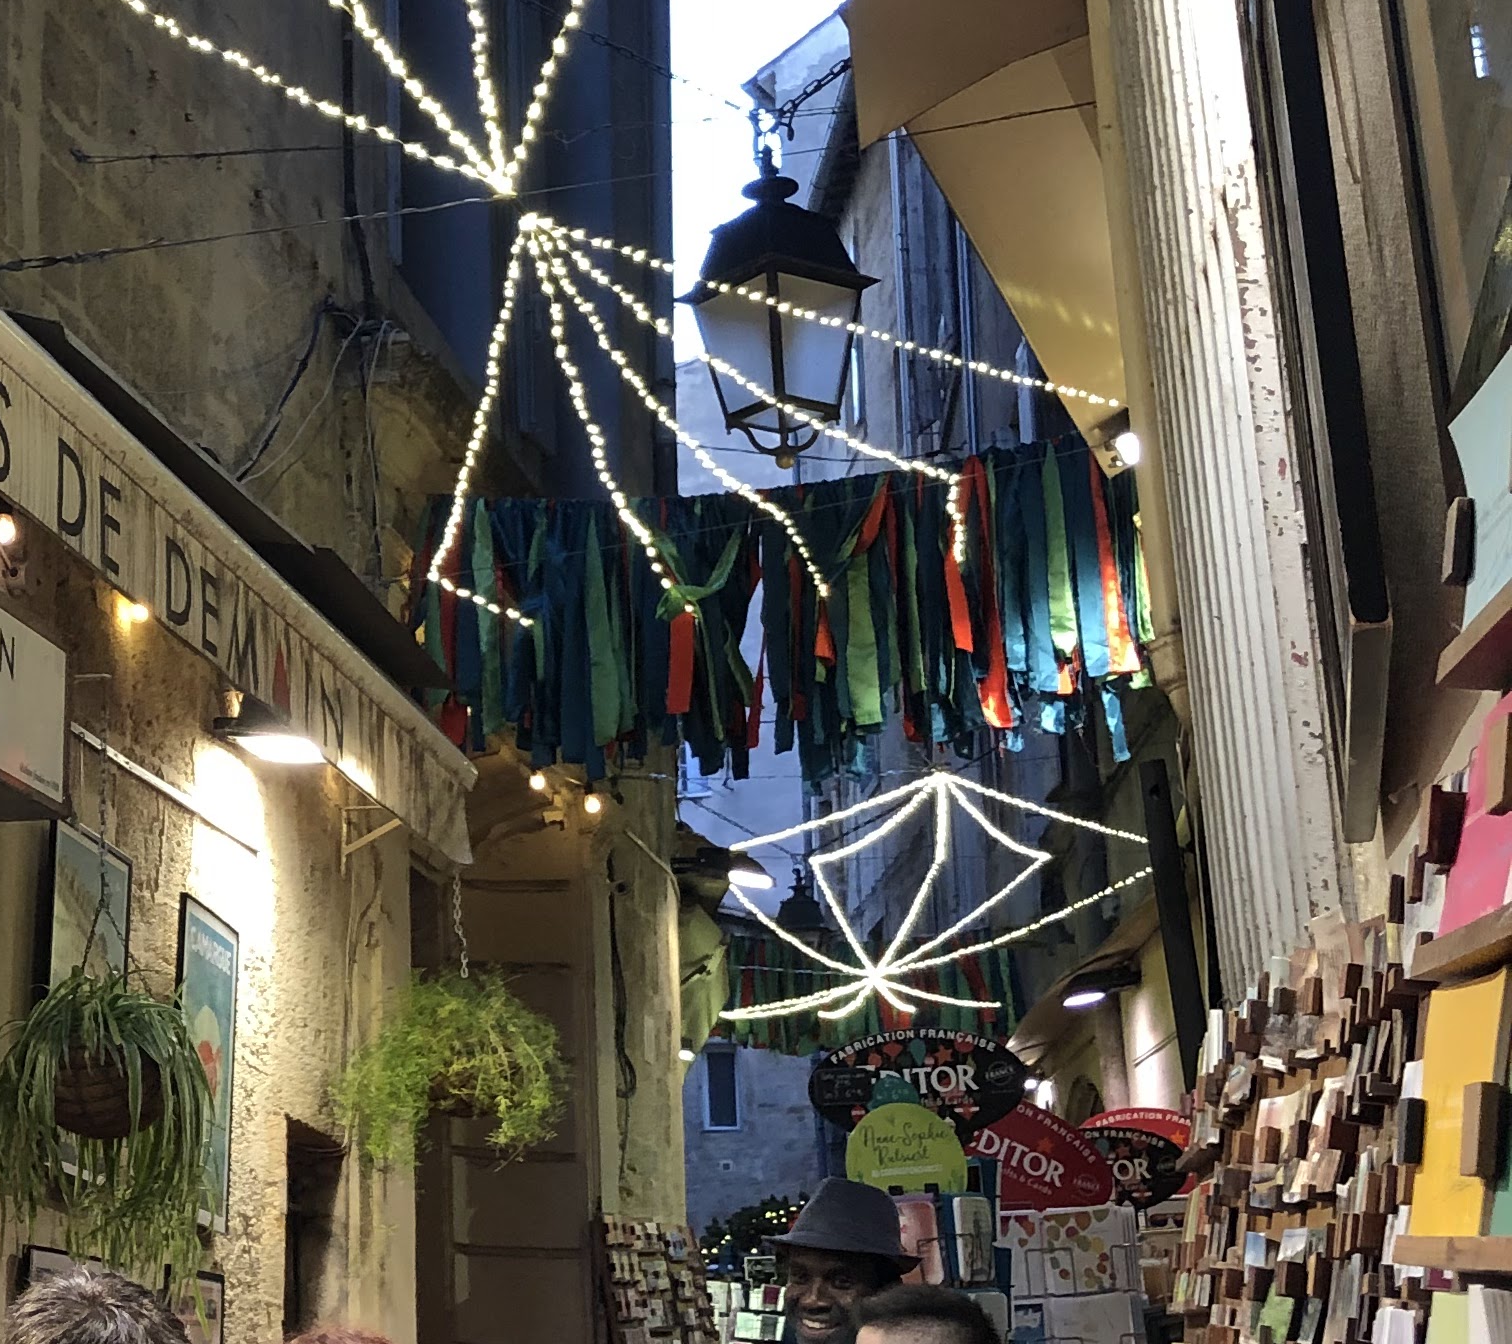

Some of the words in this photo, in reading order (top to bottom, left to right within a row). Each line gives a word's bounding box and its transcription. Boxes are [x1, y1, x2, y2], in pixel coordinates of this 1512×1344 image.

[56, 436, 122, 576] DE
[830, 1030, 915, 1065] FABRICATION
[919, 1028, 996, 1053] FRANÇAISE
[1095, 1111, 1162, 1127] FABRICATION
[969, 1128, 1065, 1188] DITOR
